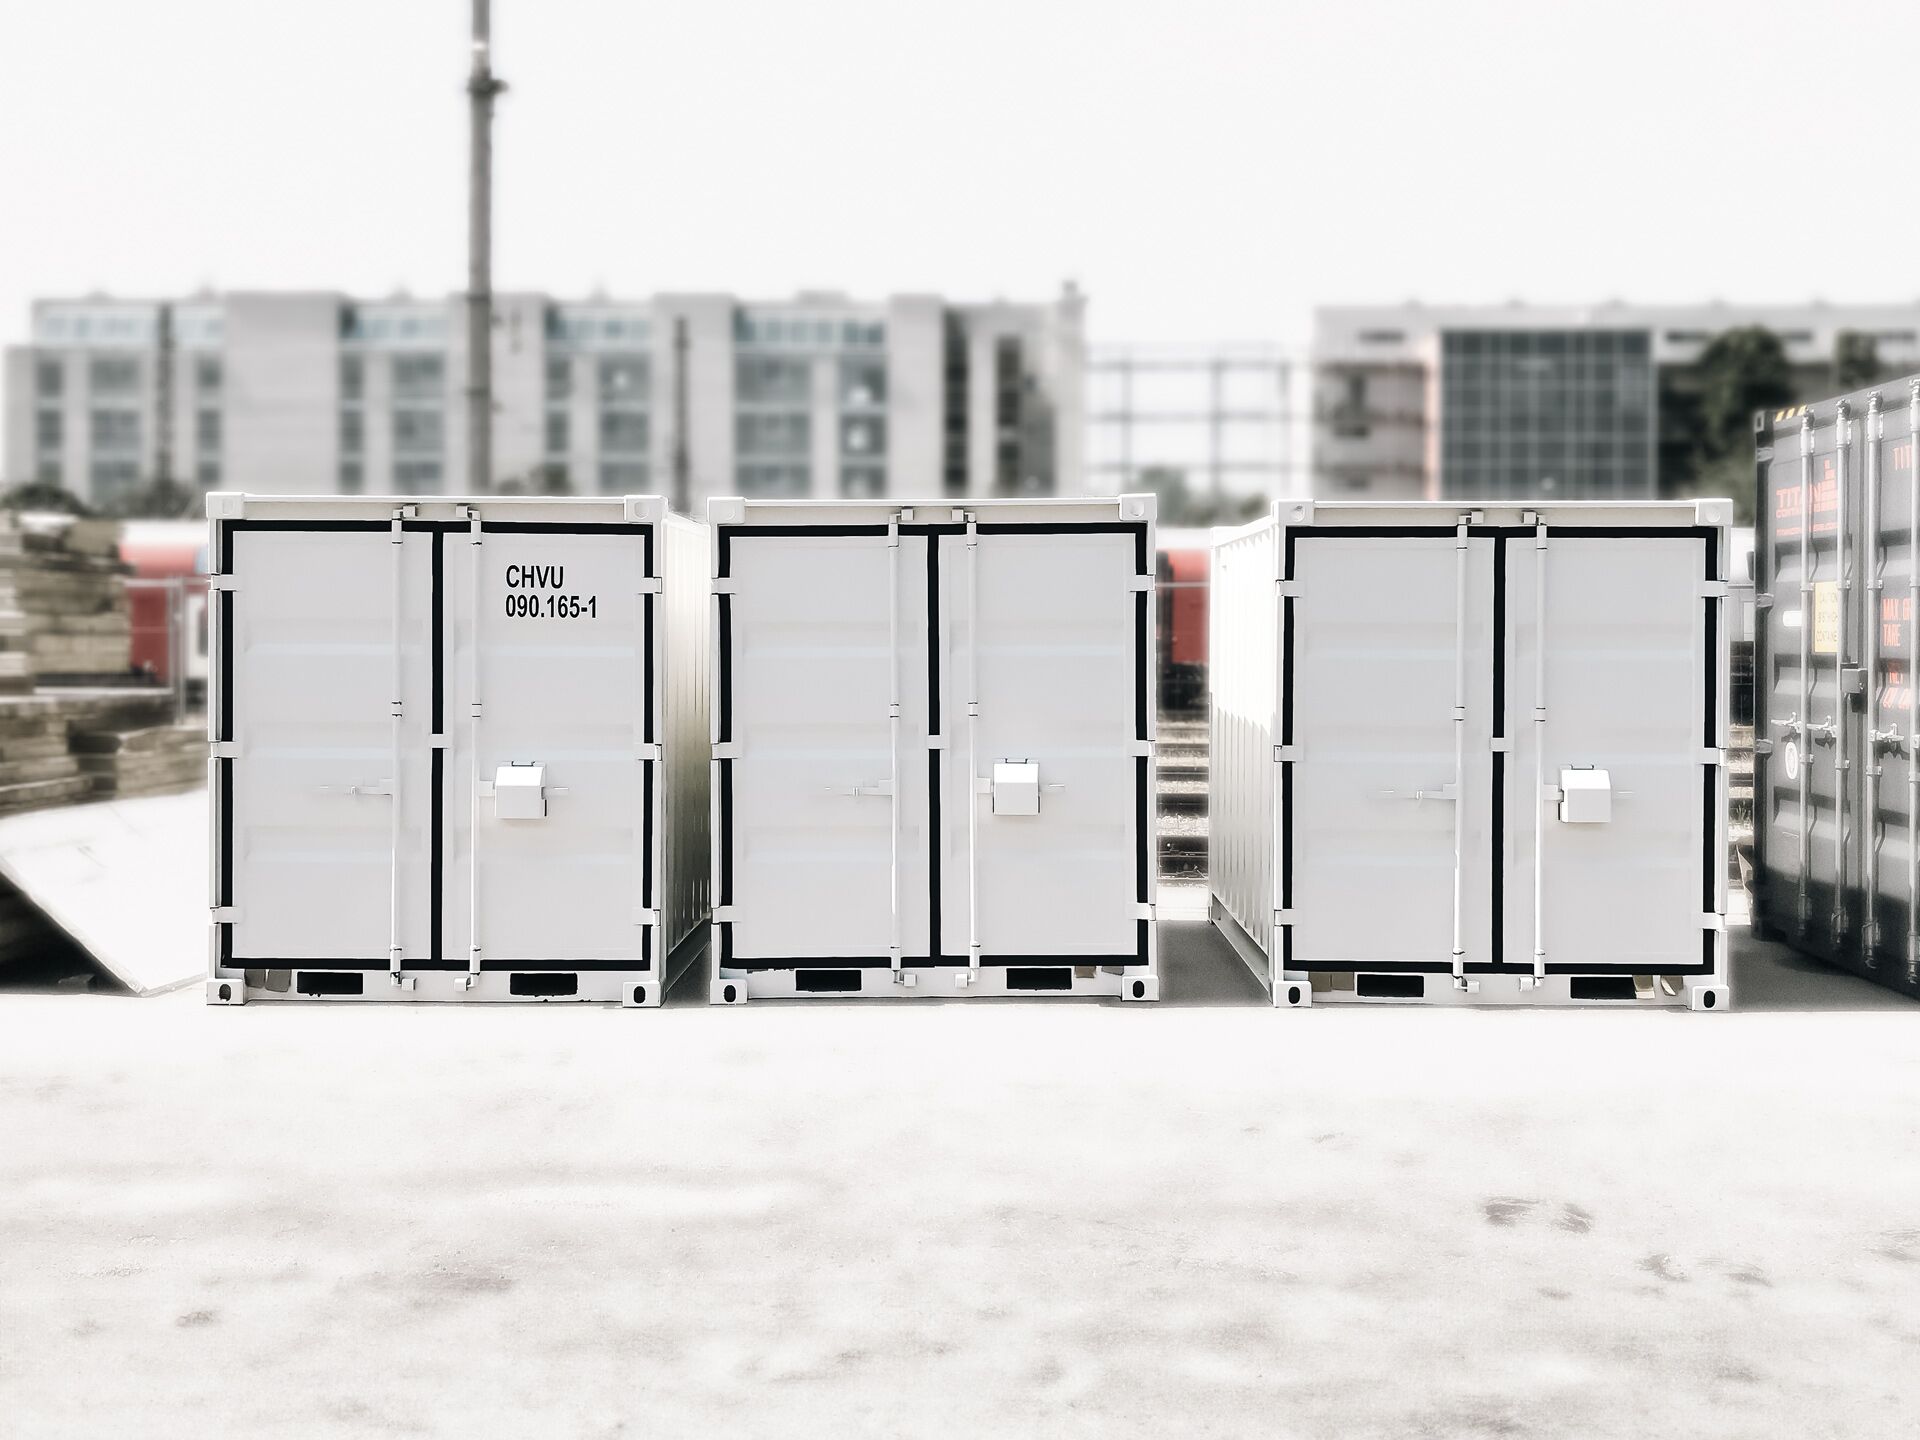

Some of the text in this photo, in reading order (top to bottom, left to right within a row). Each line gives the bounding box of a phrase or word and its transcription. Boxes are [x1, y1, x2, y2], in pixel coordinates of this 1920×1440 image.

[1776, 481, 1822, 509] TITN
[506, 565, 564, 589] CHVU
[505, 594, 597, 618] 090.165-1
